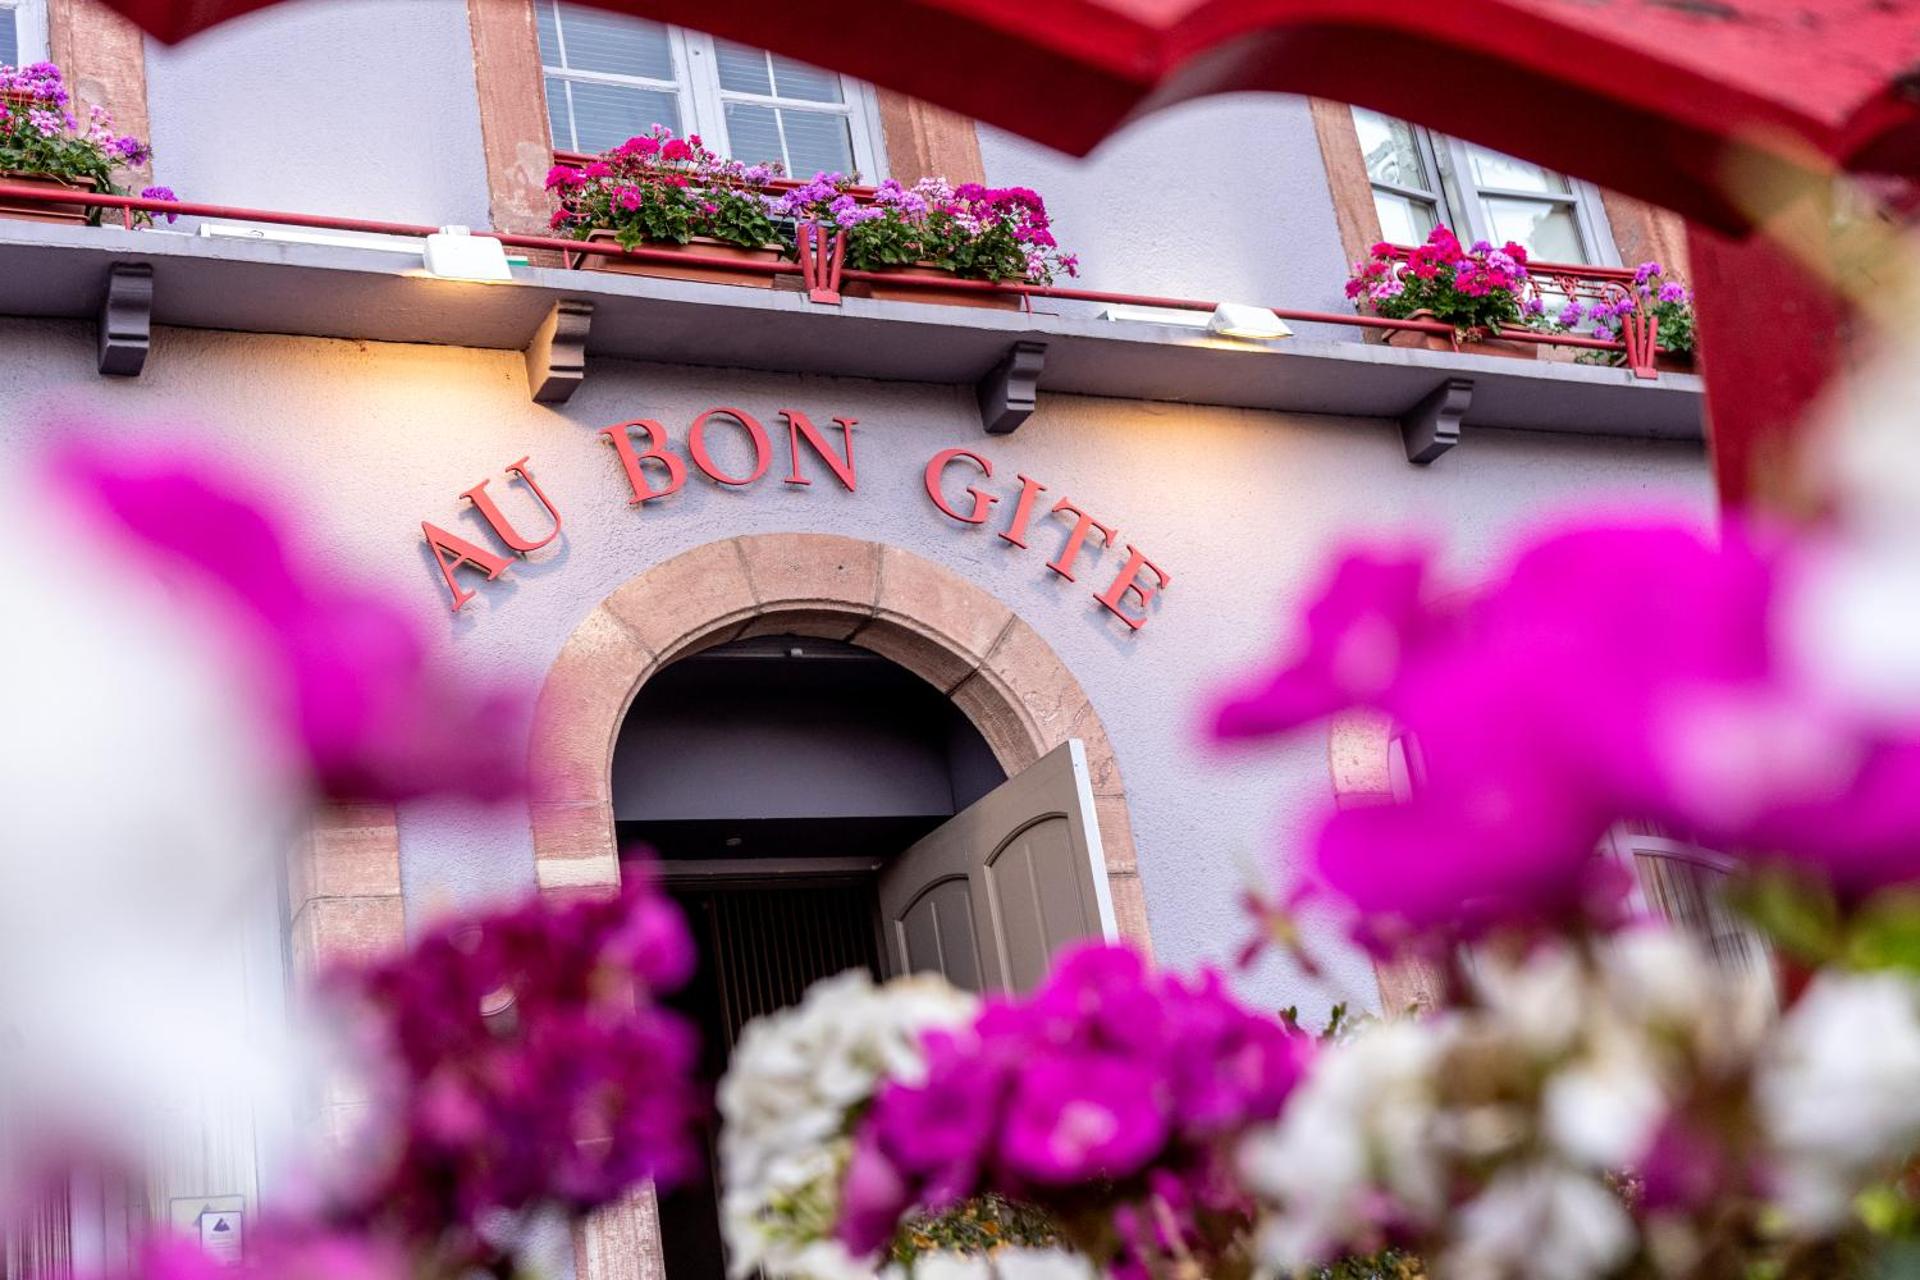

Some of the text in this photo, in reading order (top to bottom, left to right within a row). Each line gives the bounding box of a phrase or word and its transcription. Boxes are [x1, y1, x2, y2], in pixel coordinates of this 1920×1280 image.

[421, 407, 1172, 631] AU BON GITE
